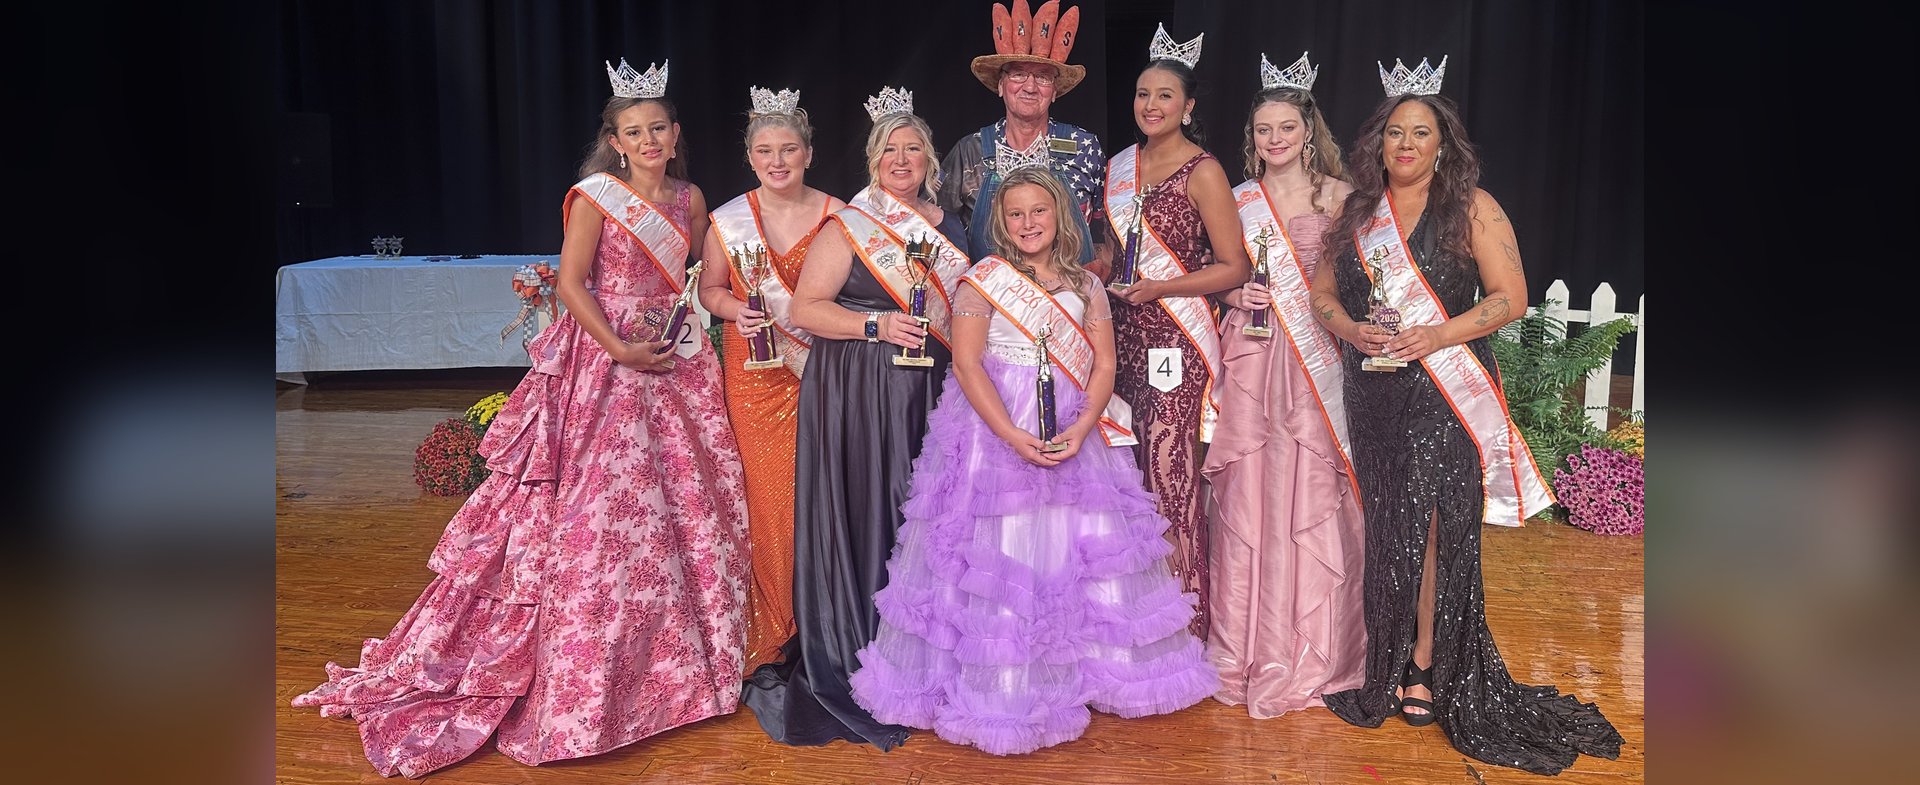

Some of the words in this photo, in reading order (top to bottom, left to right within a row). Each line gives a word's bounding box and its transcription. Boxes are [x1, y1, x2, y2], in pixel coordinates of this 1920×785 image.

[997, 20, 1072, 47] YAMS
[938, 240, 962, 267] 026
[1008, 280, 1042, 309] 2026
[644, 309, 662, 323] 2026
[1380, 314, 1399, 322] 2026
[680, 322, 693, 344] 2
[1157, 356, 1173, 377] 4
